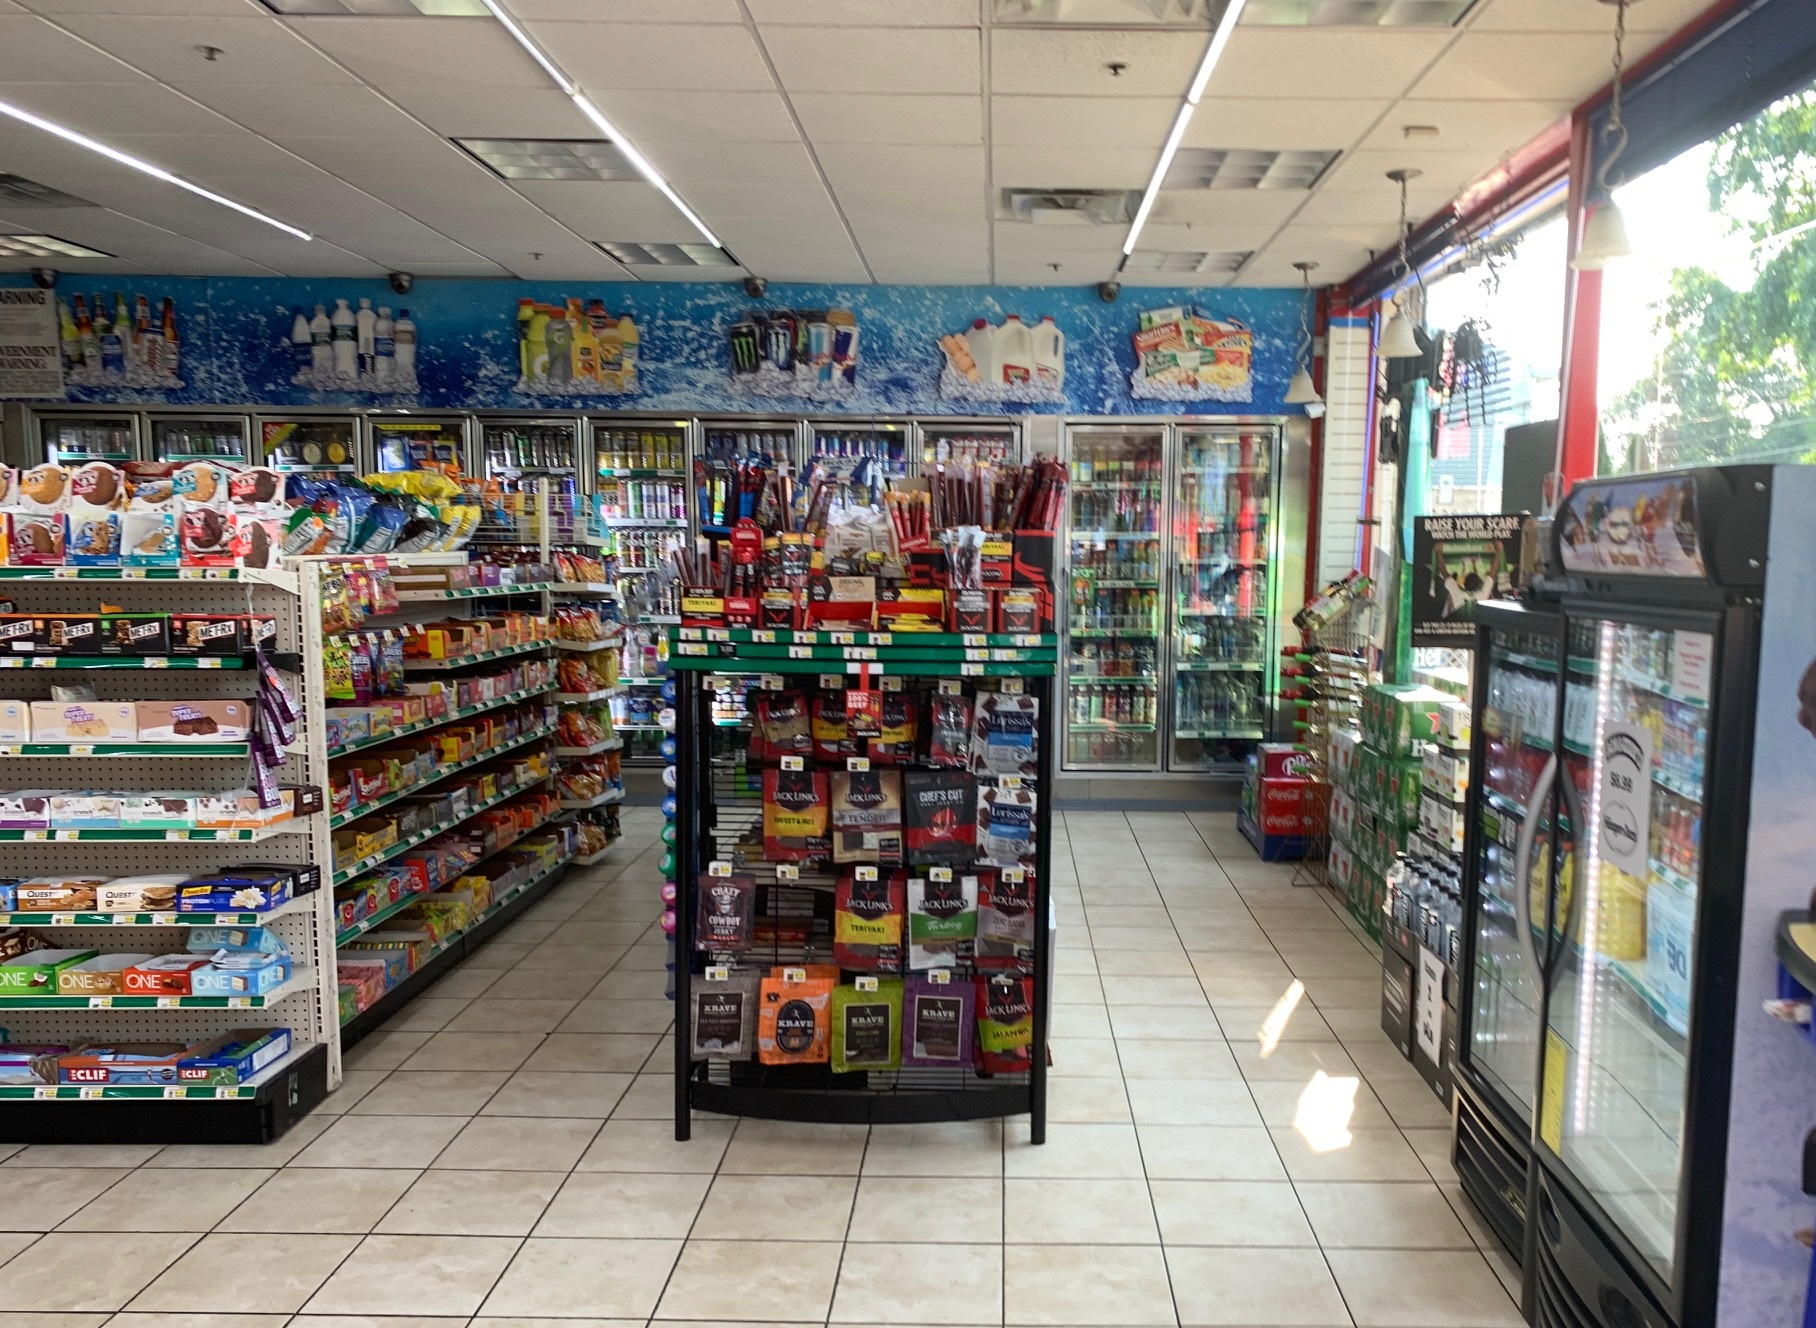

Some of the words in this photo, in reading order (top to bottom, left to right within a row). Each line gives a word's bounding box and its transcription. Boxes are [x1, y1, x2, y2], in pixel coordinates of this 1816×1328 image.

[1424, 518, 1453, 531] RAISE
[1454, 517, 1485, 530] YOUR
[772, 791, 795, 802] JACK
[947, 789, 963, 801] CUT
[848, 815, 886, 824] TENDER
[27, 890, 52, 898] QUEST
[106, 890, 132, 899] QUEST
[711, 886, 741, 898] CRAZY
[846, 898, 867, 909] JACK
[867, 899, 894, 911] LINK'S
[918, 898, 941, 911] JACK
[708, 915, 741, 926] COWBOY
[713, 927, 735, 935] JERKY
[851, 924, 885, 933] TERIYAKI
[191, 929, 229, 944] ONE
[59, 973, 95, 989] ONE
[126, 973, 162, 989] ONE
[194, 974, 230, 990] ONE
[703, 1004, 737, 1013] KRAVE
[922, 1009, 955, 1019] KRAVE
[985, 1005, 1006, 1016] JACK
[777, 1019, 814, 1029] KRAVE
[851, 1015, 884, 1024] KRAVE
[76, 1069, 106, 1080] CLIF
[185, 1069, 208, 1078] CLIF
